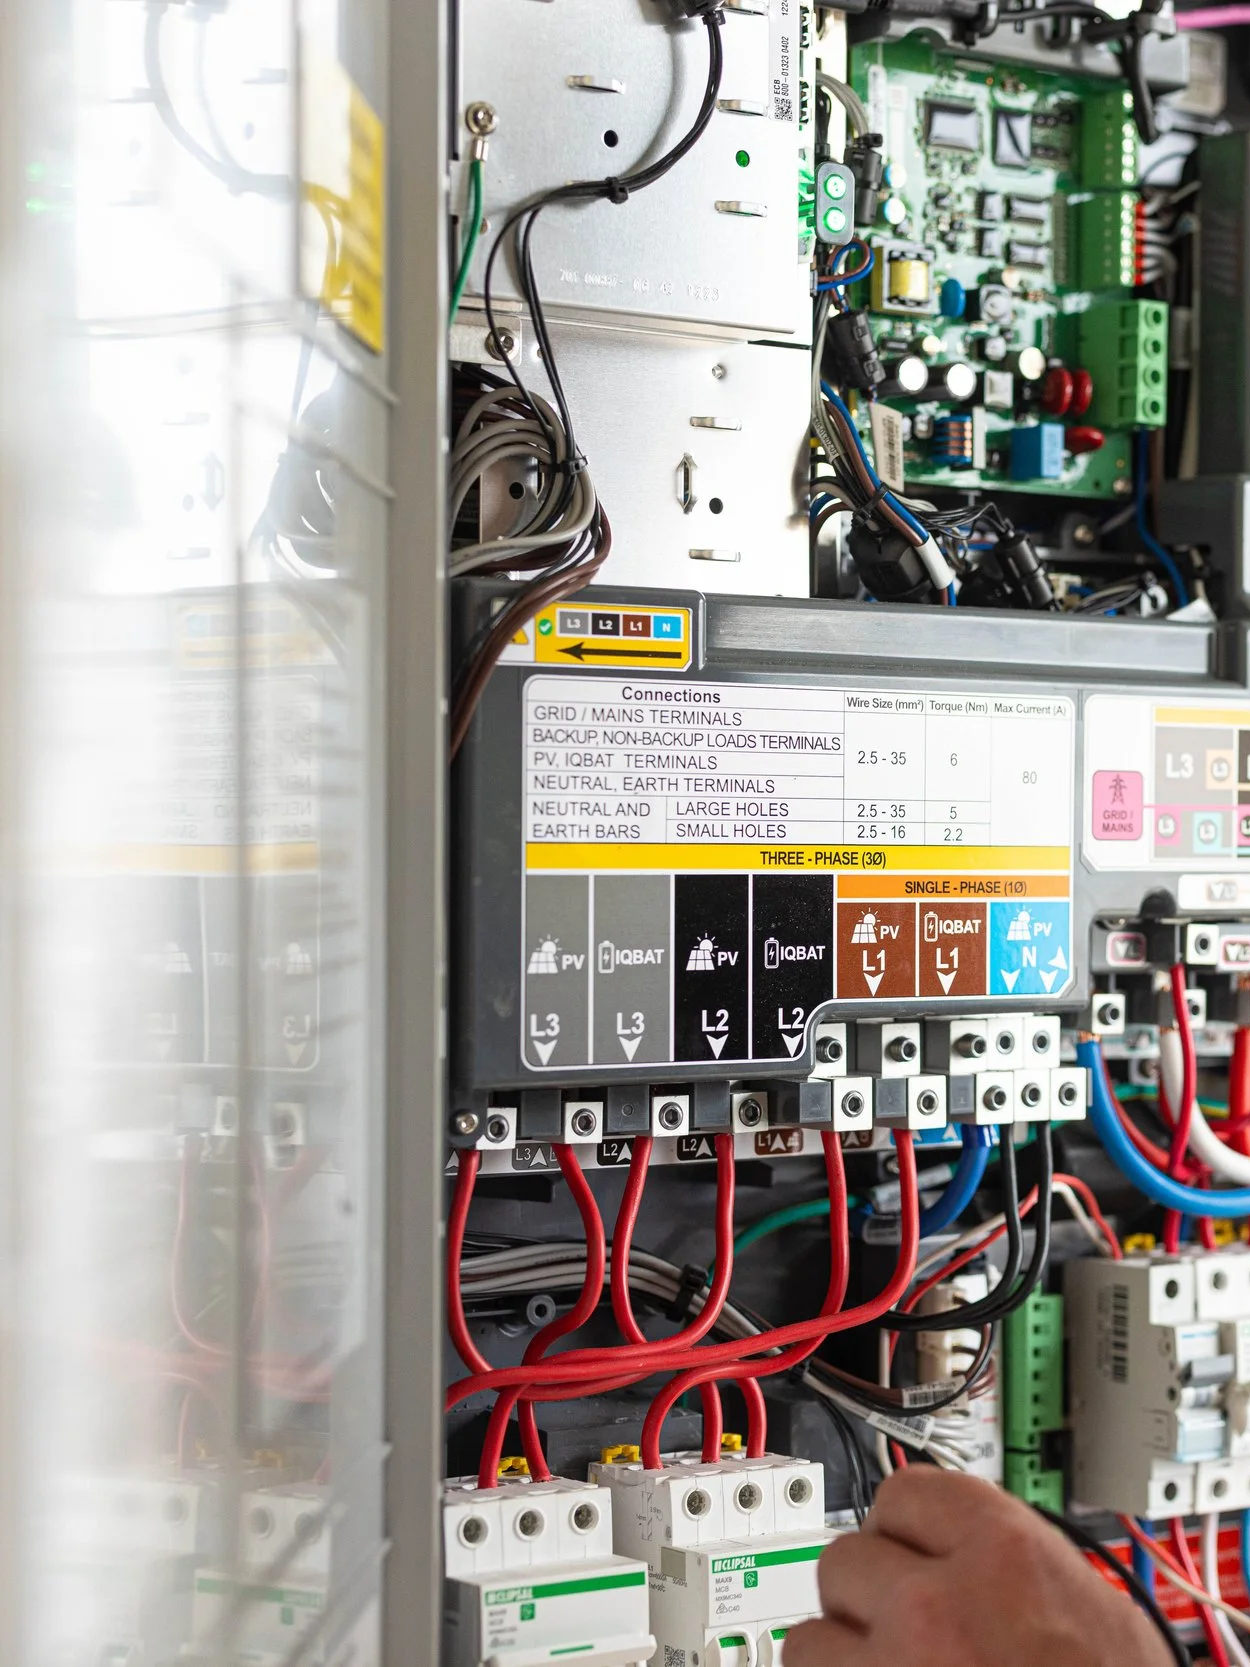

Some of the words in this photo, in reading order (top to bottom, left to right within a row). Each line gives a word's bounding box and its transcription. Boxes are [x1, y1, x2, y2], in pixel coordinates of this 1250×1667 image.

[781, 36, 790, 54] 0402
[567, 618, 581, 629] L3
[599, 620, 613, 630] L2
[630, 621, 643, 631] L1
[662, 622, 671, 632] N
[621, 686, 721, 704] Connections
[847, 697, 870, 708] Wire
[872, 697, 893, 709] Size
[929, 700, 963, 712] Torque
[965, 702, 988, 714] (Nm)
[994, 703, 1013, 713] Max
[1016, 704, 1051, 714] Current
[1053, 705, 1066, 717] (A)
[534, 706, 577, 722] GRID
[592, 708, 645, 724] MAINS
[650, 709, 743, 727] TERMINALS
[533, 728, 600, 746] BACKUP,
[603, 731, 704, 748] NON-BACKUP
[707, 734, 757, 749] LOADS
[760, 735, 842, 751] TERMINALS
[534, 751, 559, 768] PV,
[565, 752, 615, 769] IQBAT
[624, 754, 718, 770] TERMINALS
[857, 750, 878, 765] 2.5
[891, 752, 906, 766] 35
[950, 752, 958, 766] 6
[1165, 752, 1195, 780] L3
[533, 775, 618, 793] NEUTRAL,
[624, 776, 679, 792] EARTH
[684, 778, 776, 794] TERMINALS
[1022, 770, 1037, 784] 80
[533, 801, 611, 817] NEUTRAL
[615, 802, 651, 818] AND
[676, 801, 731, 817] LARGE
[736, 802, 790, 818] HOLES
[857, 804, 878, 818] 2.5
[890, 804, 906, 818] 35
[950, 806, 958, 820] 5
[1102, 809, 1128, 820] GRID
[533, 824, 590, 839] EARTH
[595, 824, 641, 839] BARS
[676, 823, 729, 839] SMALL
[734, 823, 787, 839] HOLES
[857, 824, 878, 838] 2.5
[891, 825, 906, 839] 16
[944, 828, 963, 842] 2.2
[1102, 822, 1134, 833] MAINS
[760, 852, 805, 866] THREE
[815, 852, 859, 866] PHASE
[904, 881, 950, 894] SINGLE
[960, 881, 1002, 894] PHASE
[880, 925, 900, 940] PV
[939, 918, 982, 934] IQBAT
[1034, 922, 1053, 936] PV
[615, 948, 665, 965] IQBAT
[718, 952, 740, 966] PV
[780, 946, 826, 961] IQBAT
[862, 949, 886, 972] L1
[936, 947, 959, 969] L1
[1022, 946, 1037, 968] N
[561, 954, 586, 970] PV
[530, 1013, 560, 1037] L3
[616, 1012, 646, 1035] L3
[701, 1009, 730, 1032] L2
[778, 1008, 805, 1030] L2
[682, 1140, 698, 1152] L2
[758, 1133, 772, 1147] L1
[515, 1148, 531, 1161] L3
[602, 1144, 618, 1156] L2
[721, 1556, 756, 1570] CLIPSAL
